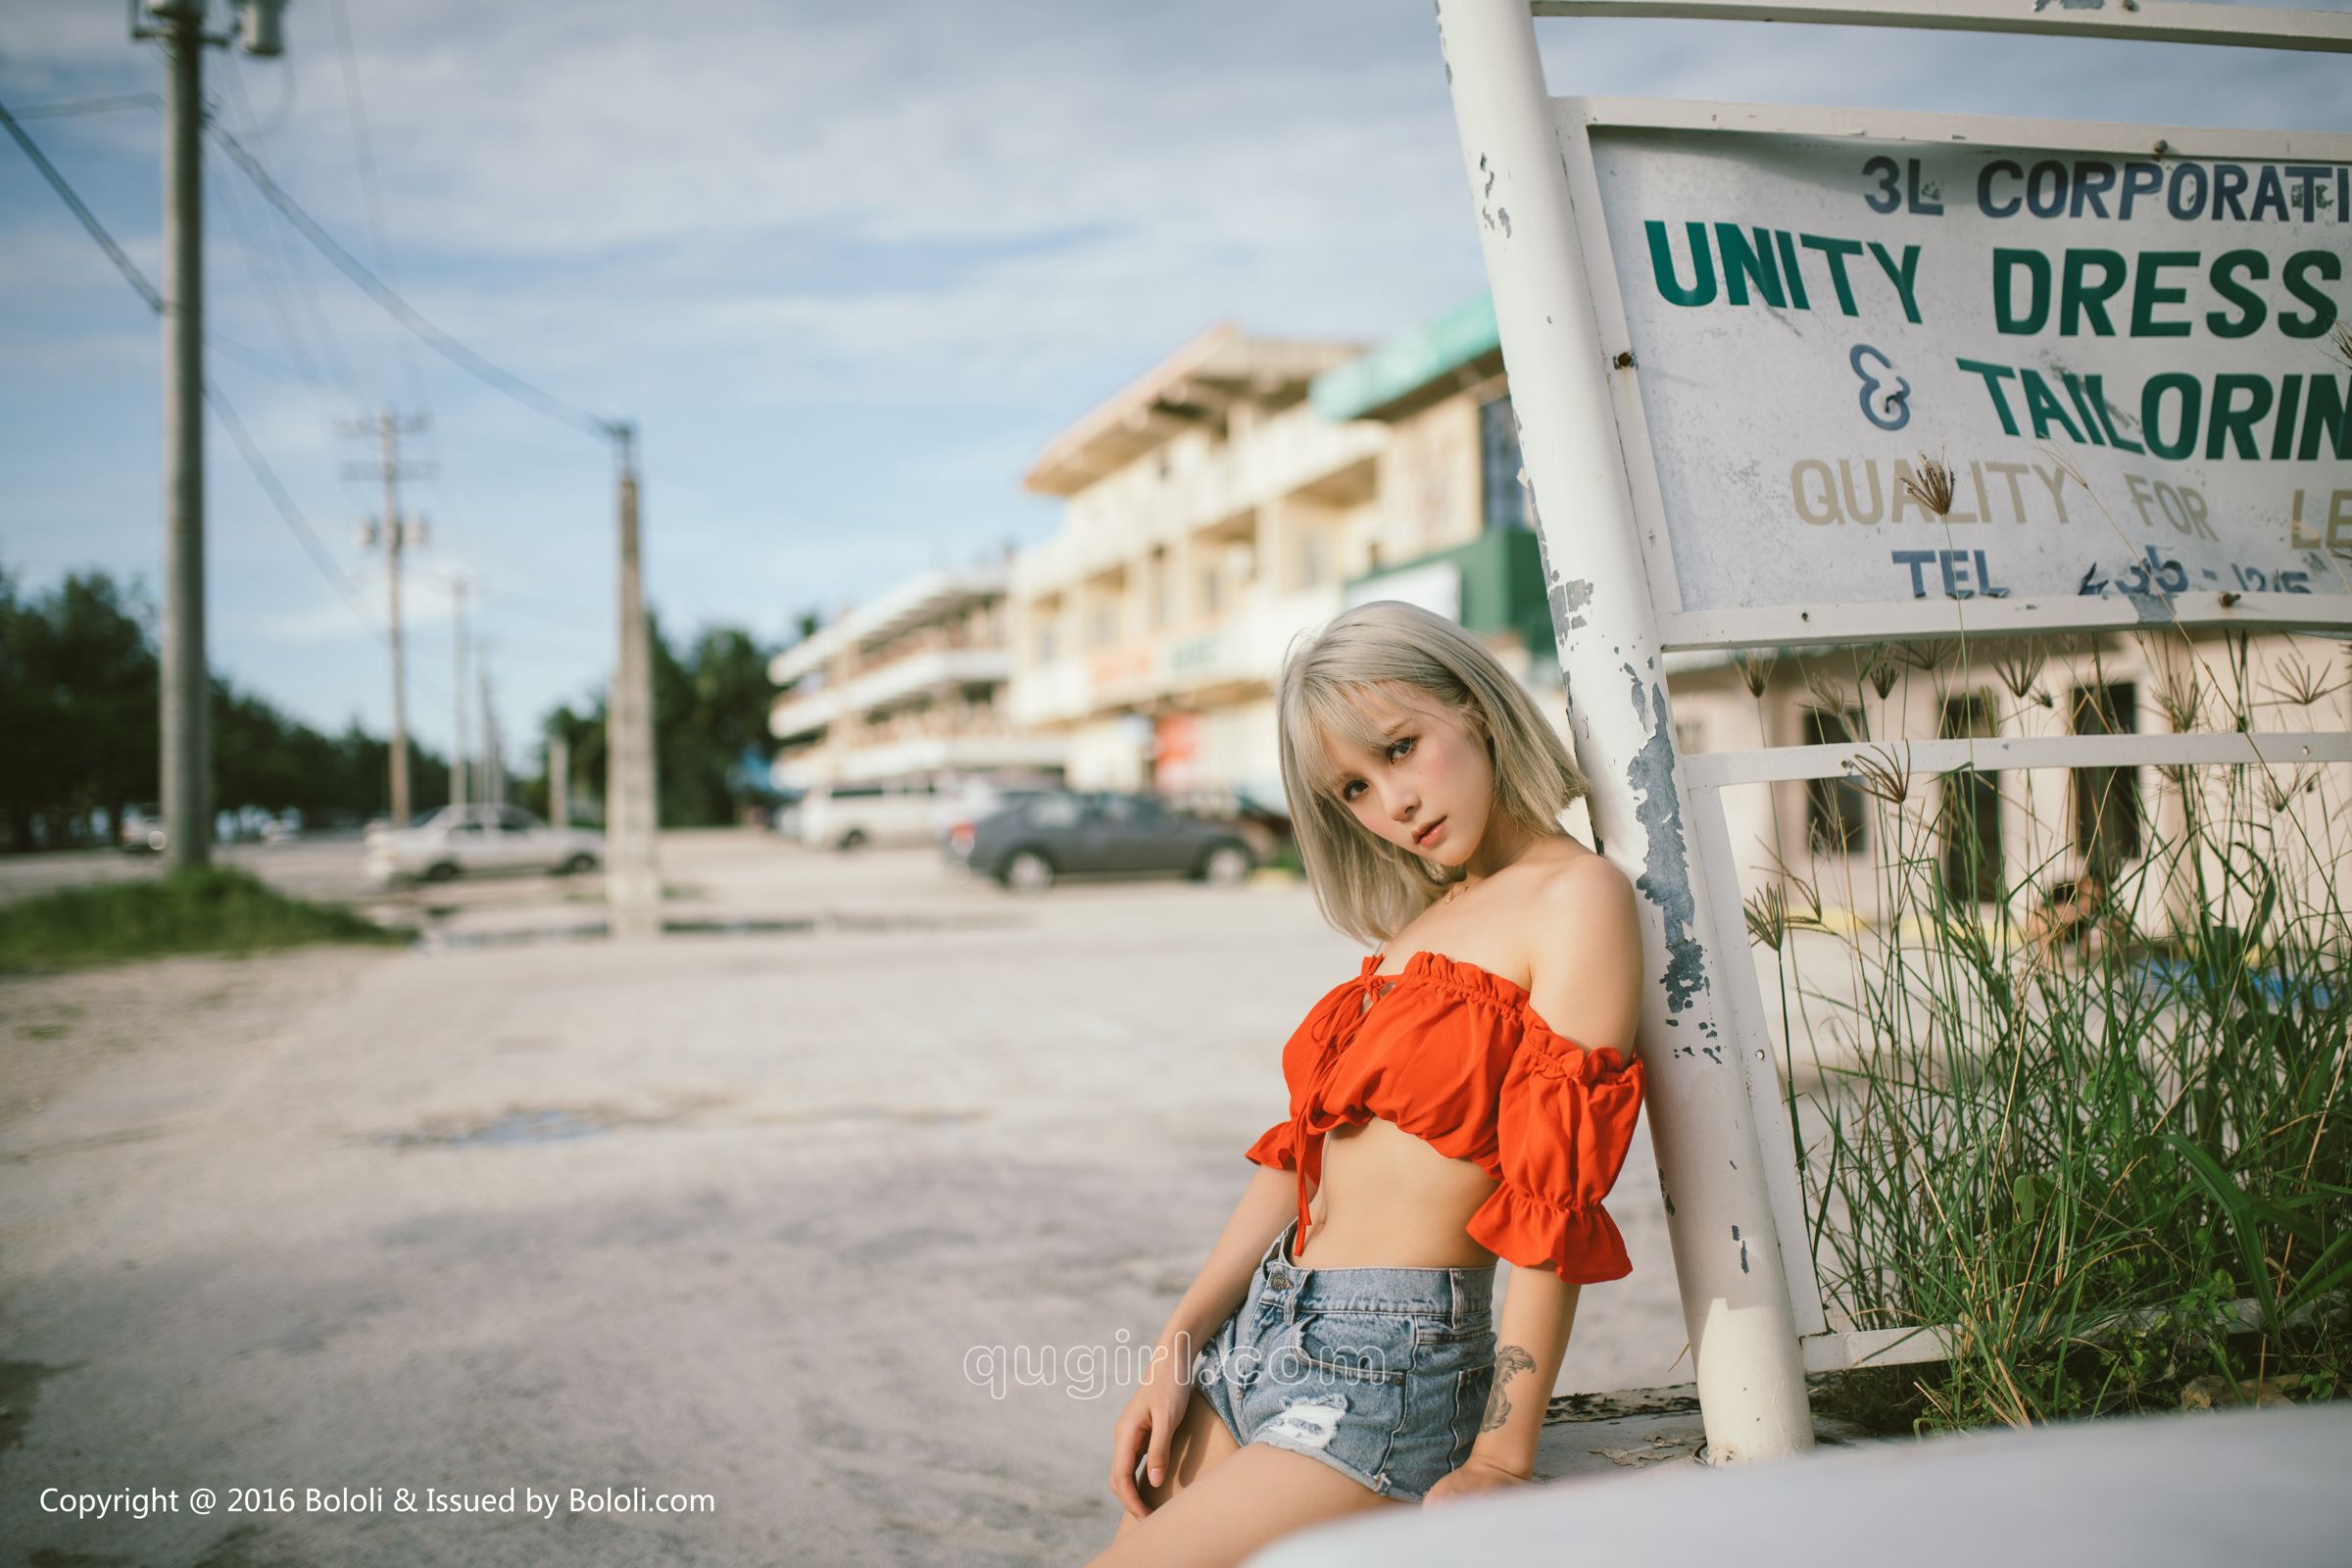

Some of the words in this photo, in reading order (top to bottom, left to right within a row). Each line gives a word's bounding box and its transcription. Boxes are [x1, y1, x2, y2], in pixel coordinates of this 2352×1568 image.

[1863, 156, 1943, 216] 3L
[1977, 160, 2350, 223] CORPORATI
[1644, 220, 1923, 323] UNITY
[1993, 248, 2342, 339] DRESS
[1850, 345, 1910, 431] &
[2124, 472, 2220, 541] FOR
[1891, 549, 2010, 600] TEL
